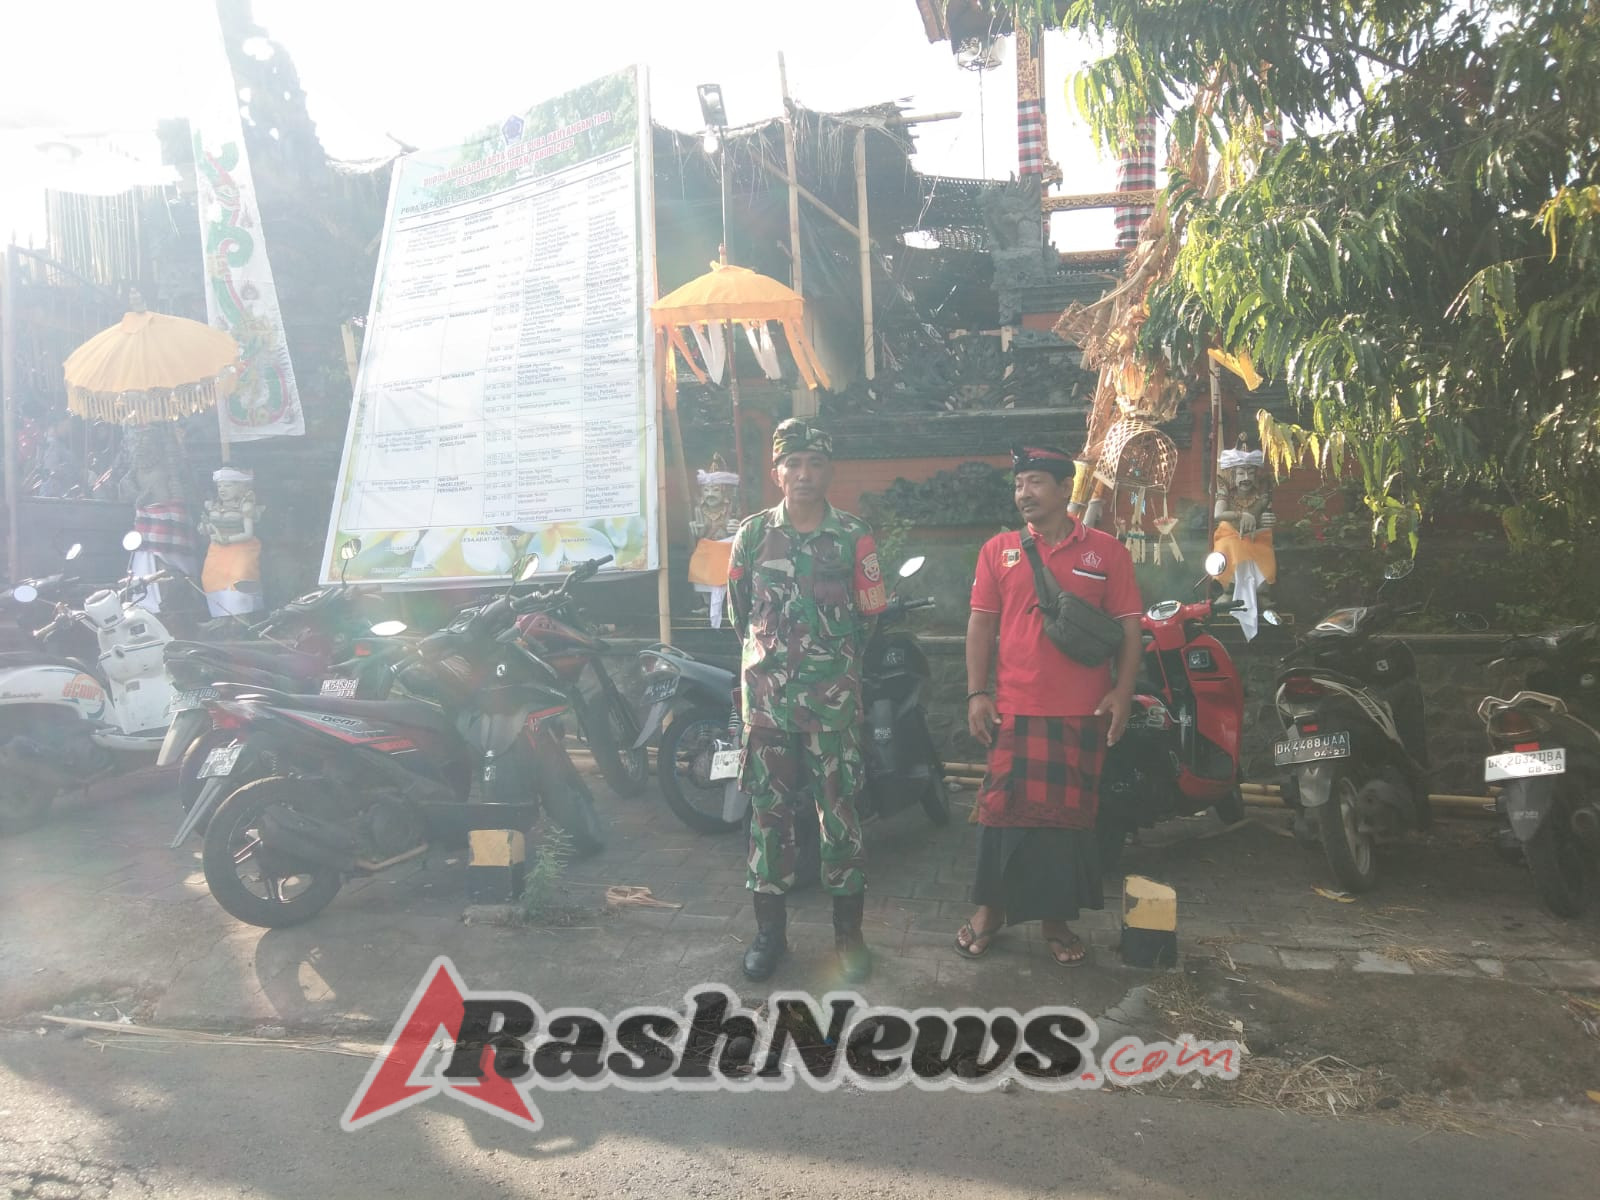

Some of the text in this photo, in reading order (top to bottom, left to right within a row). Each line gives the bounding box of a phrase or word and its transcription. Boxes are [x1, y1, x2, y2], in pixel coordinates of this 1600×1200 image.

[1276, 734, 1347, 755] DK 4488 UAA
